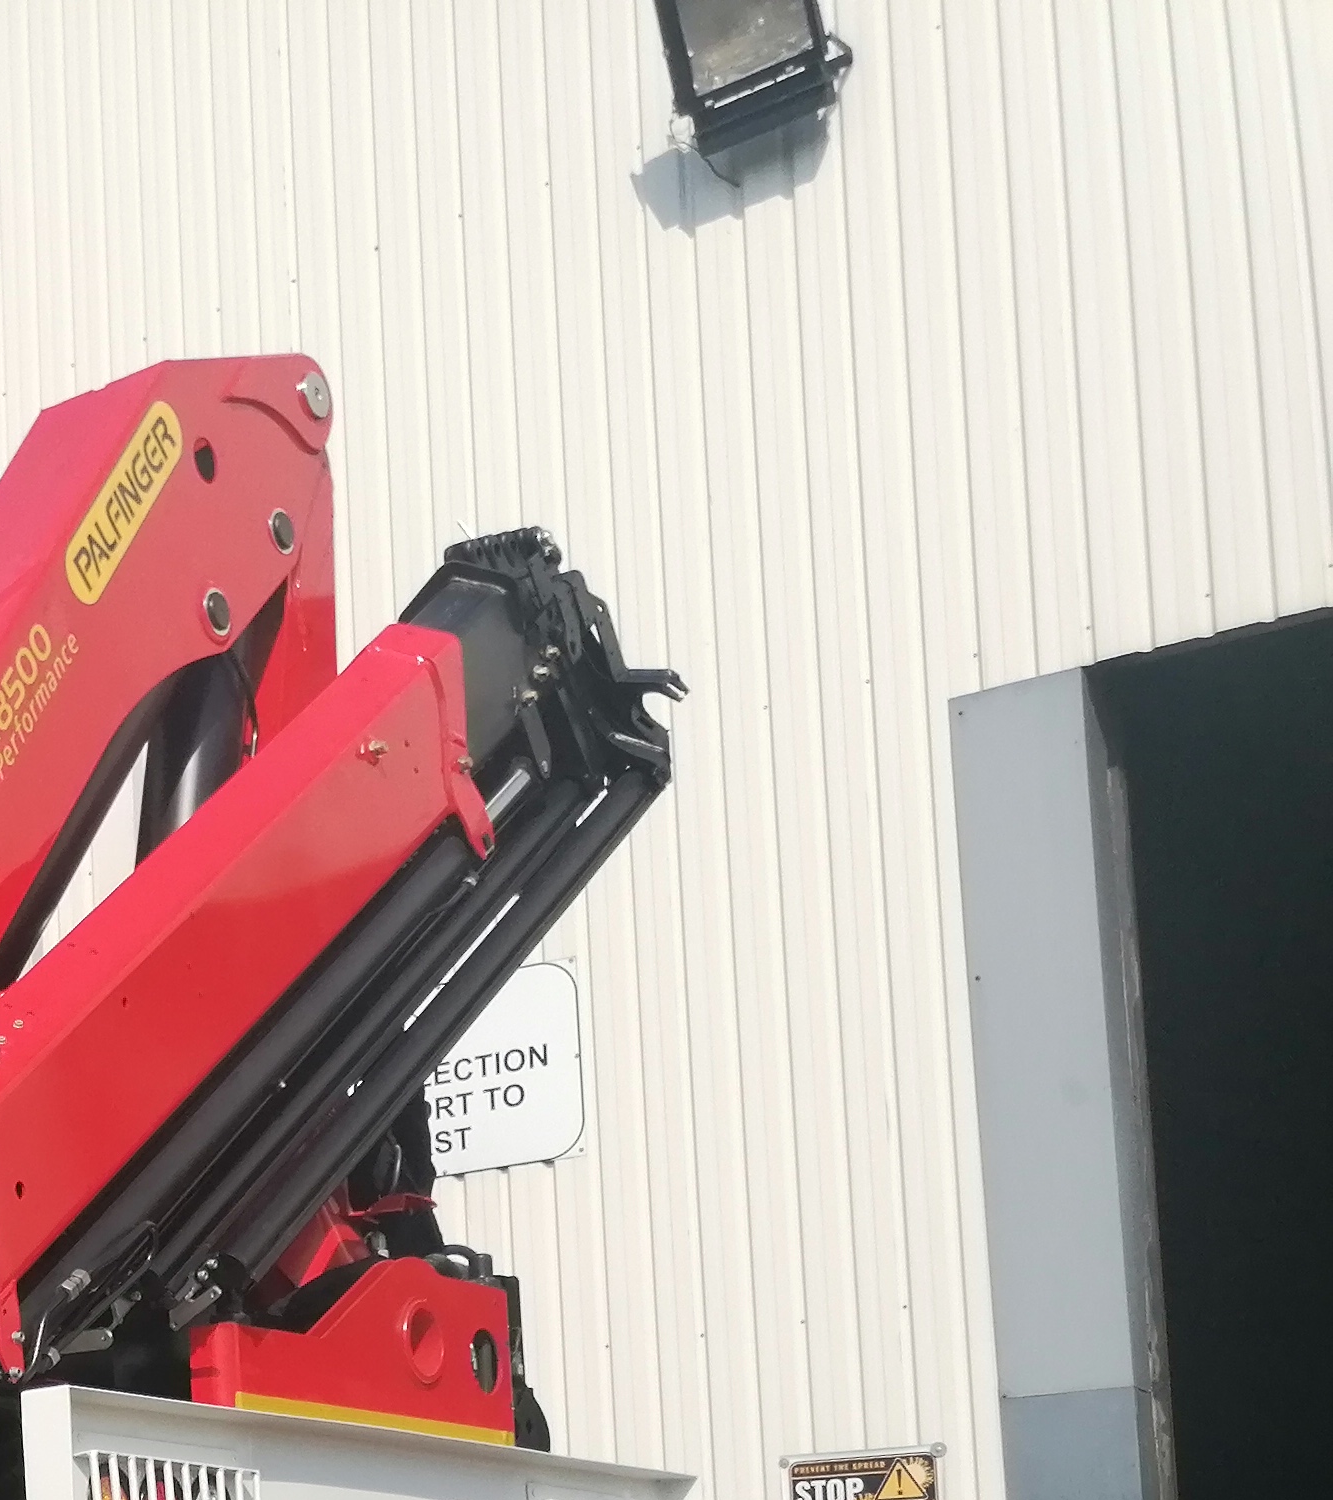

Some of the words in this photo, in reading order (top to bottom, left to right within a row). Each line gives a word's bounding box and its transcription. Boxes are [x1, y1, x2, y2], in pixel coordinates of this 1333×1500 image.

[72, 415, 178, 592] PALFINGER
[424, 1043, 548, 1087] ECTION
[483, 1084, 525, 1111] TO
[794, 1465, 831, 1475] PREVENT
[833, 1463, 849, 1471] THE
[852, 1461, 886, 1470] SPREAD
